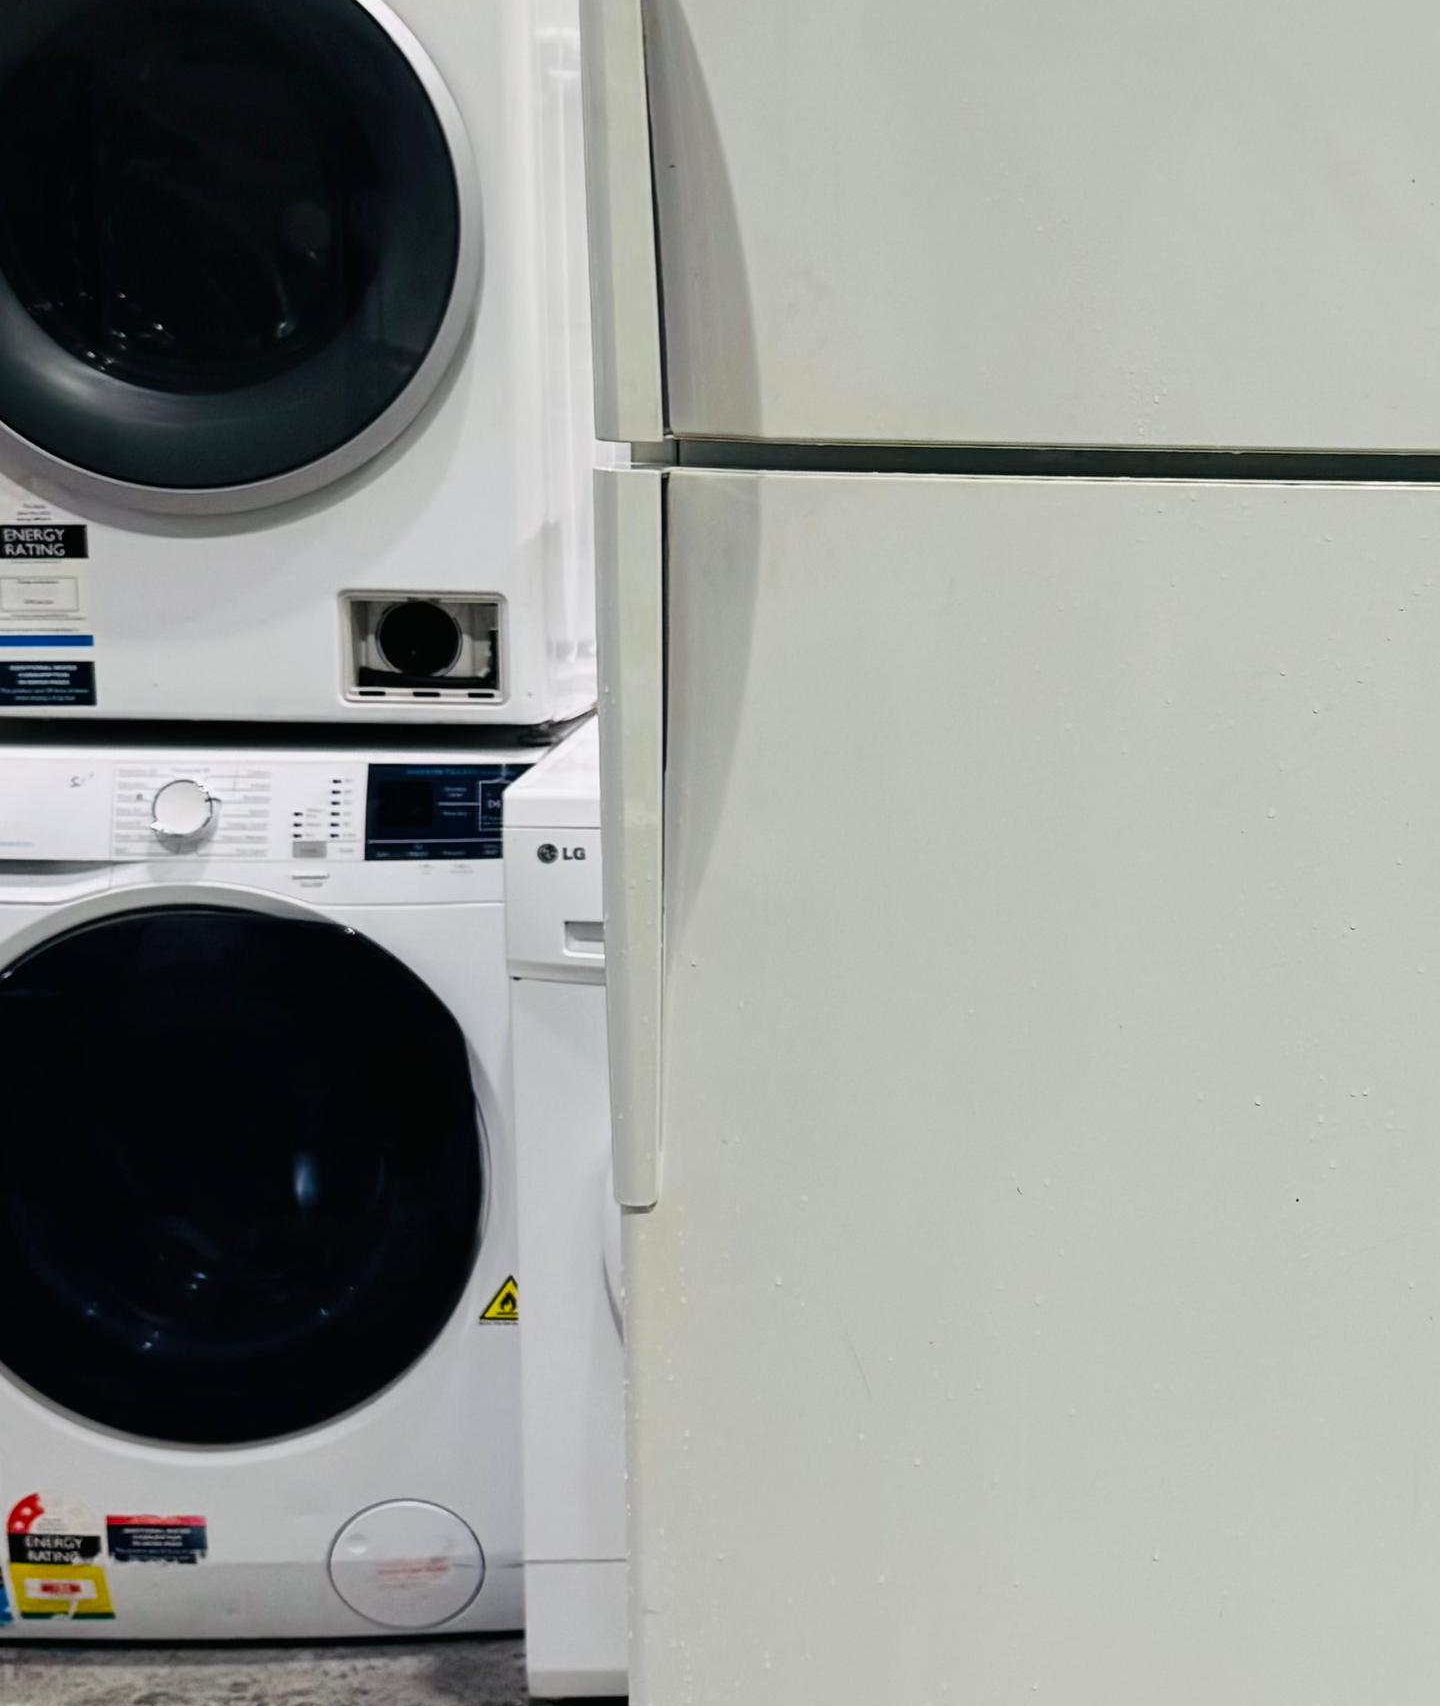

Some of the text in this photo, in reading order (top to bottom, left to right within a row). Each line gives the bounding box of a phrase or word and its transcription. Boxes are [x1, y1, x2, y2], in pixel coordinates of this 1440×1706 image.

[3, 528, 65, 542] ENERGY
[4, 543, 66, 557] RATING
[562, 847, 586, 860] LG
[25, 1536, 84, 1549] ENERGY
